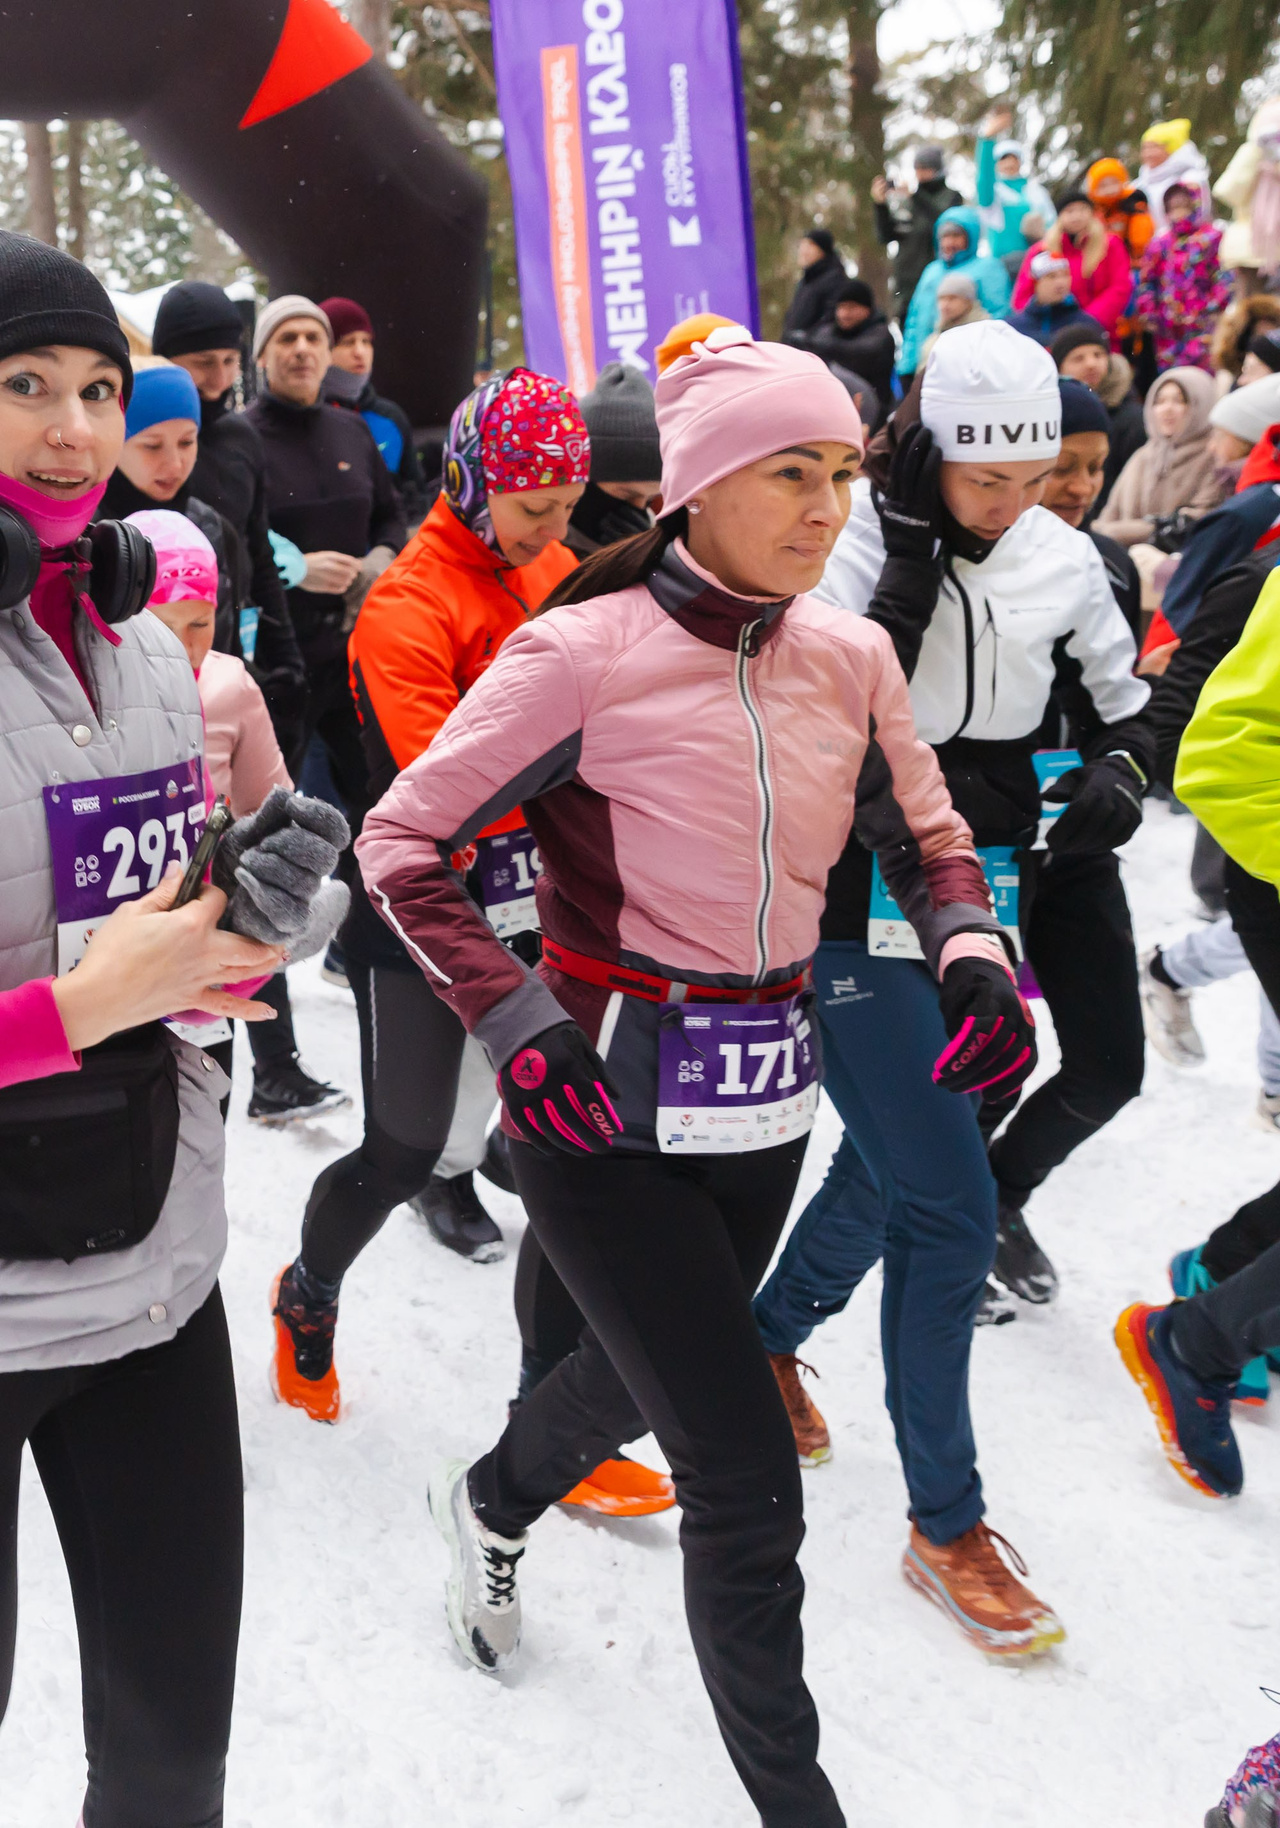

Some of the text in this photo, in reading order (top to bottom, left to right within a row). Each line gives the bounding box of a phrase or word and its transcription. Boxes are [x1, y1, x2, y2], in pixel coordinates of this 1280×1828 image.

[956, 421, 1058, 444] BIVIU
[103, 811, 189, 899] 293
[717, 1037, 797, 1095] 171
